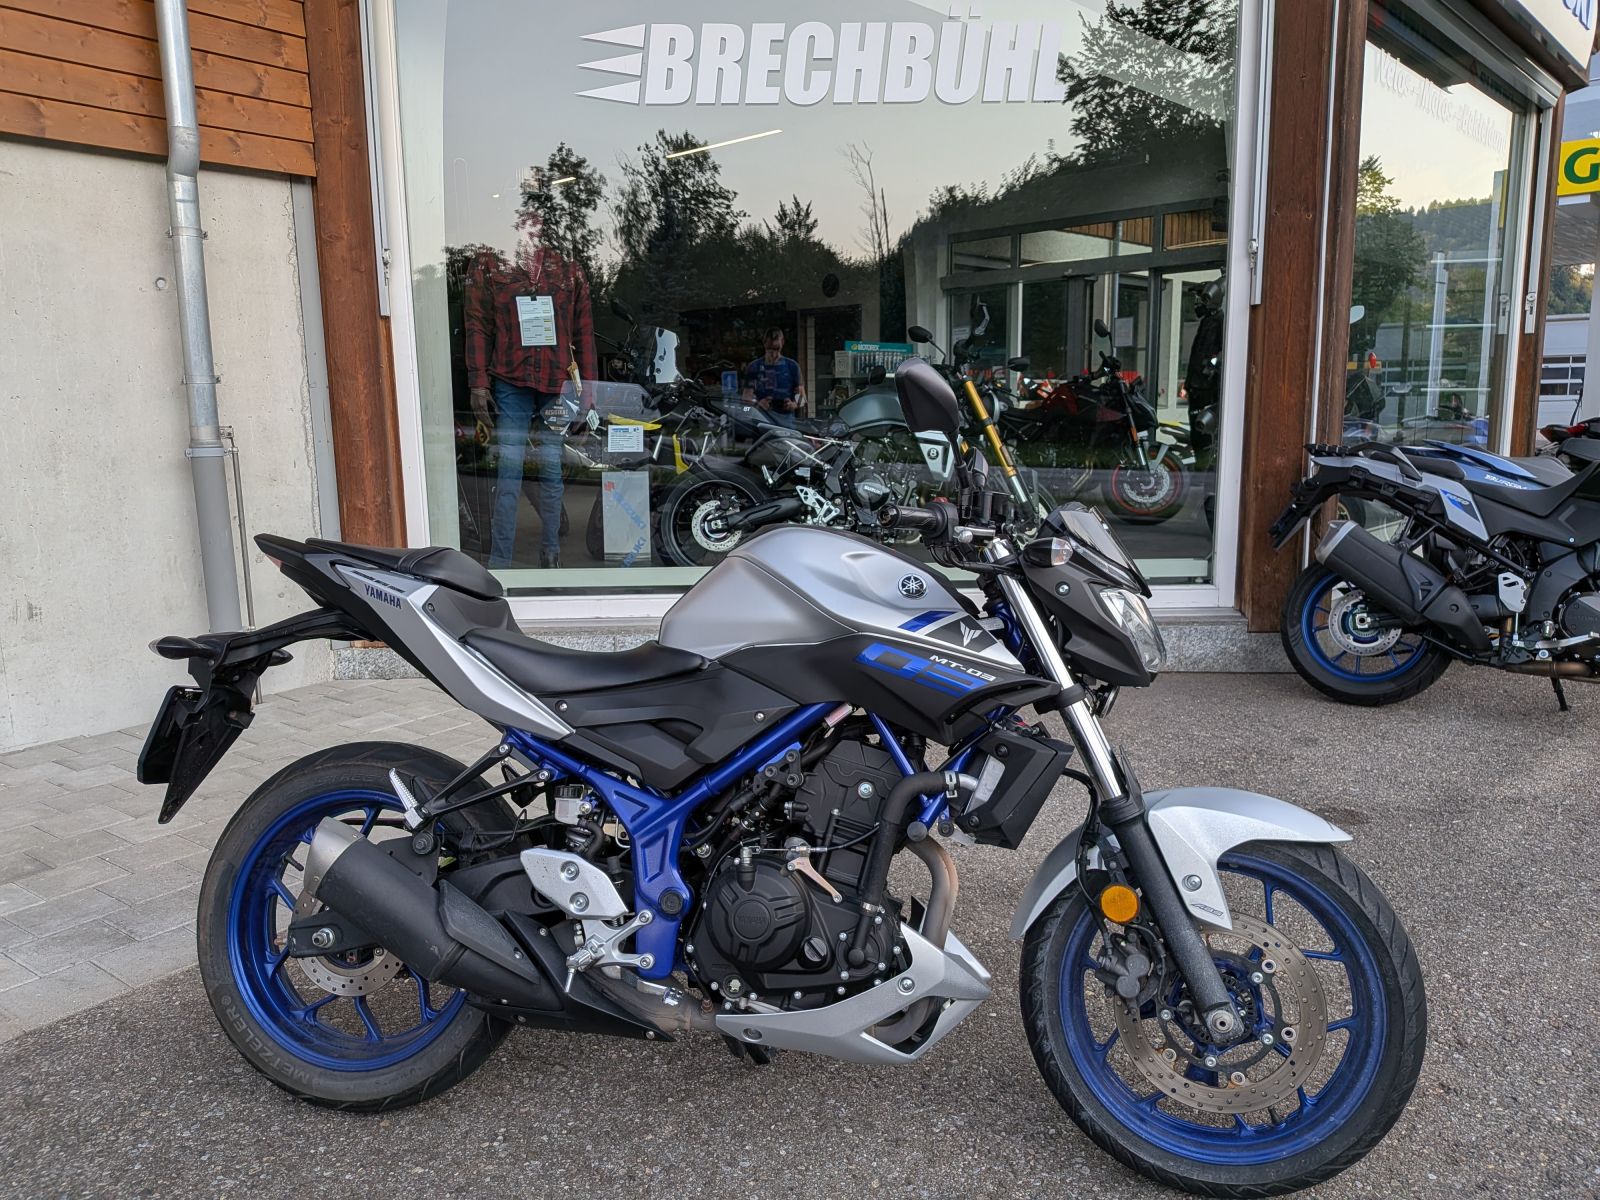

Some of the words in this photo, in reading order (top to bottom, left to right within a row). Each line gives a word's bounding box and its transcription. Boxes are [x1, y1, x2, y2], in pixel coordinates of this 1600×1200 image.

[644, 4, 1067, 105] BRECHBÜHL
[364, 583, 402, 610] YAMAHA
[928, 654, 997, 682] MT-03
[225, 1005, 311, 1084] METZELER
